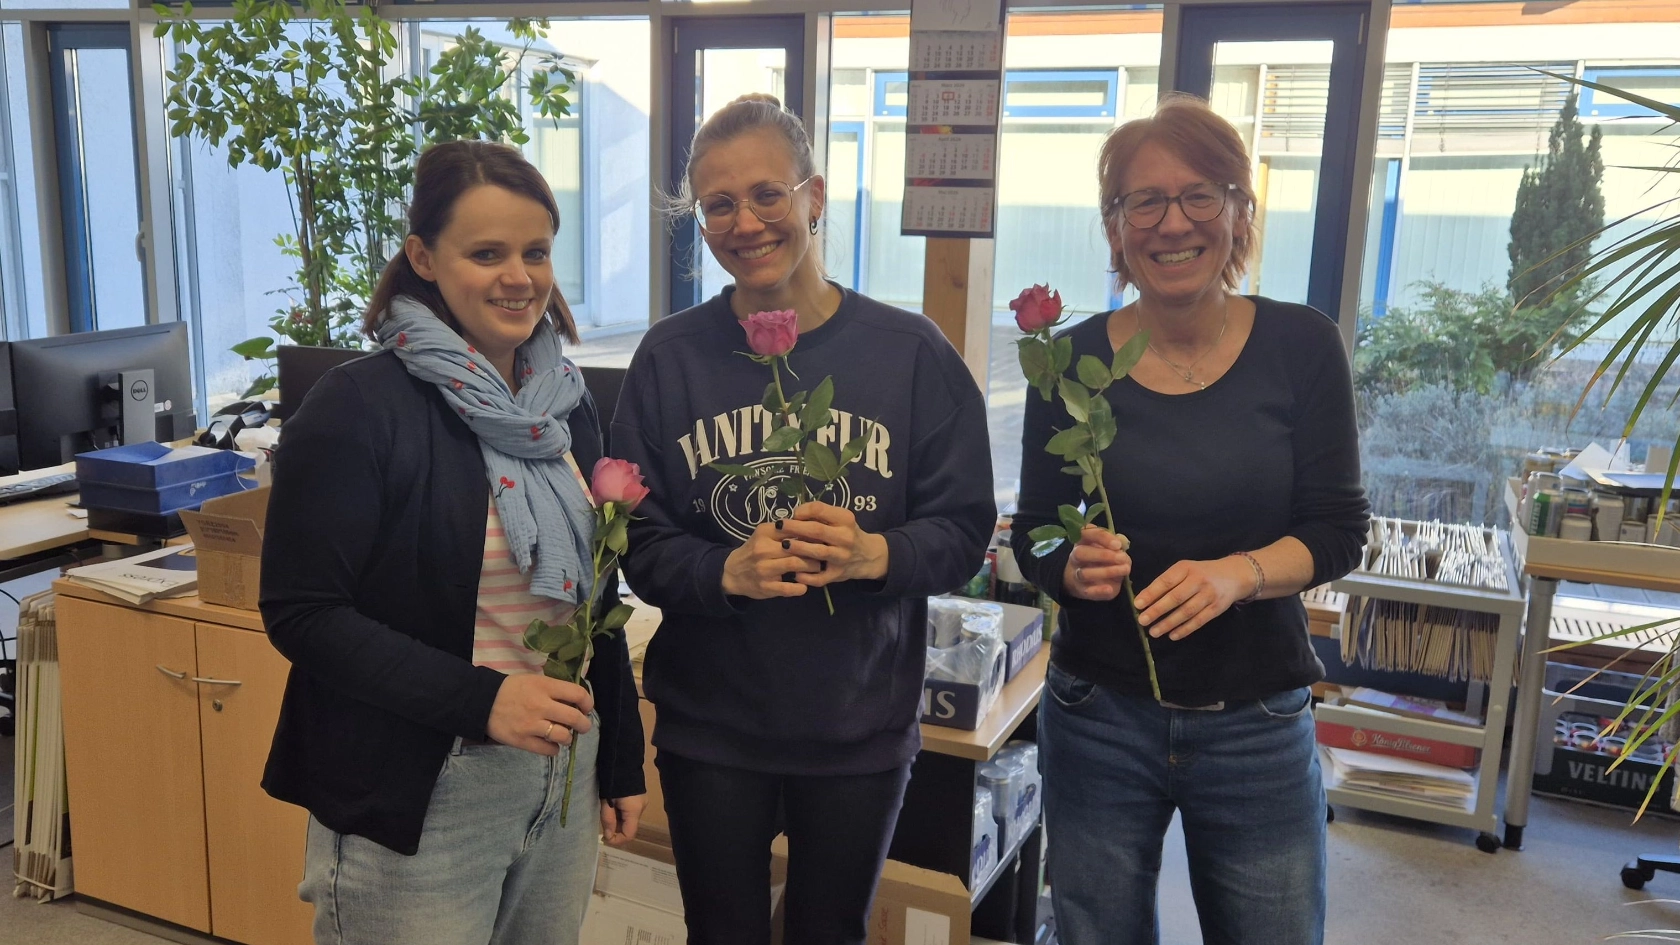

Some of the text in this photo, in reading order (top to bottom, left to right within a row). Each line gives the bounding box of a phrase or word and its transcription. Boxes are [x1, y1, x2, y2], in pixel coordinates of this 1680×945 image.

[816, 407, 893, 478] FUR
[692, 498, 706, 513] 19
[854, 496, 877, 512] 93
